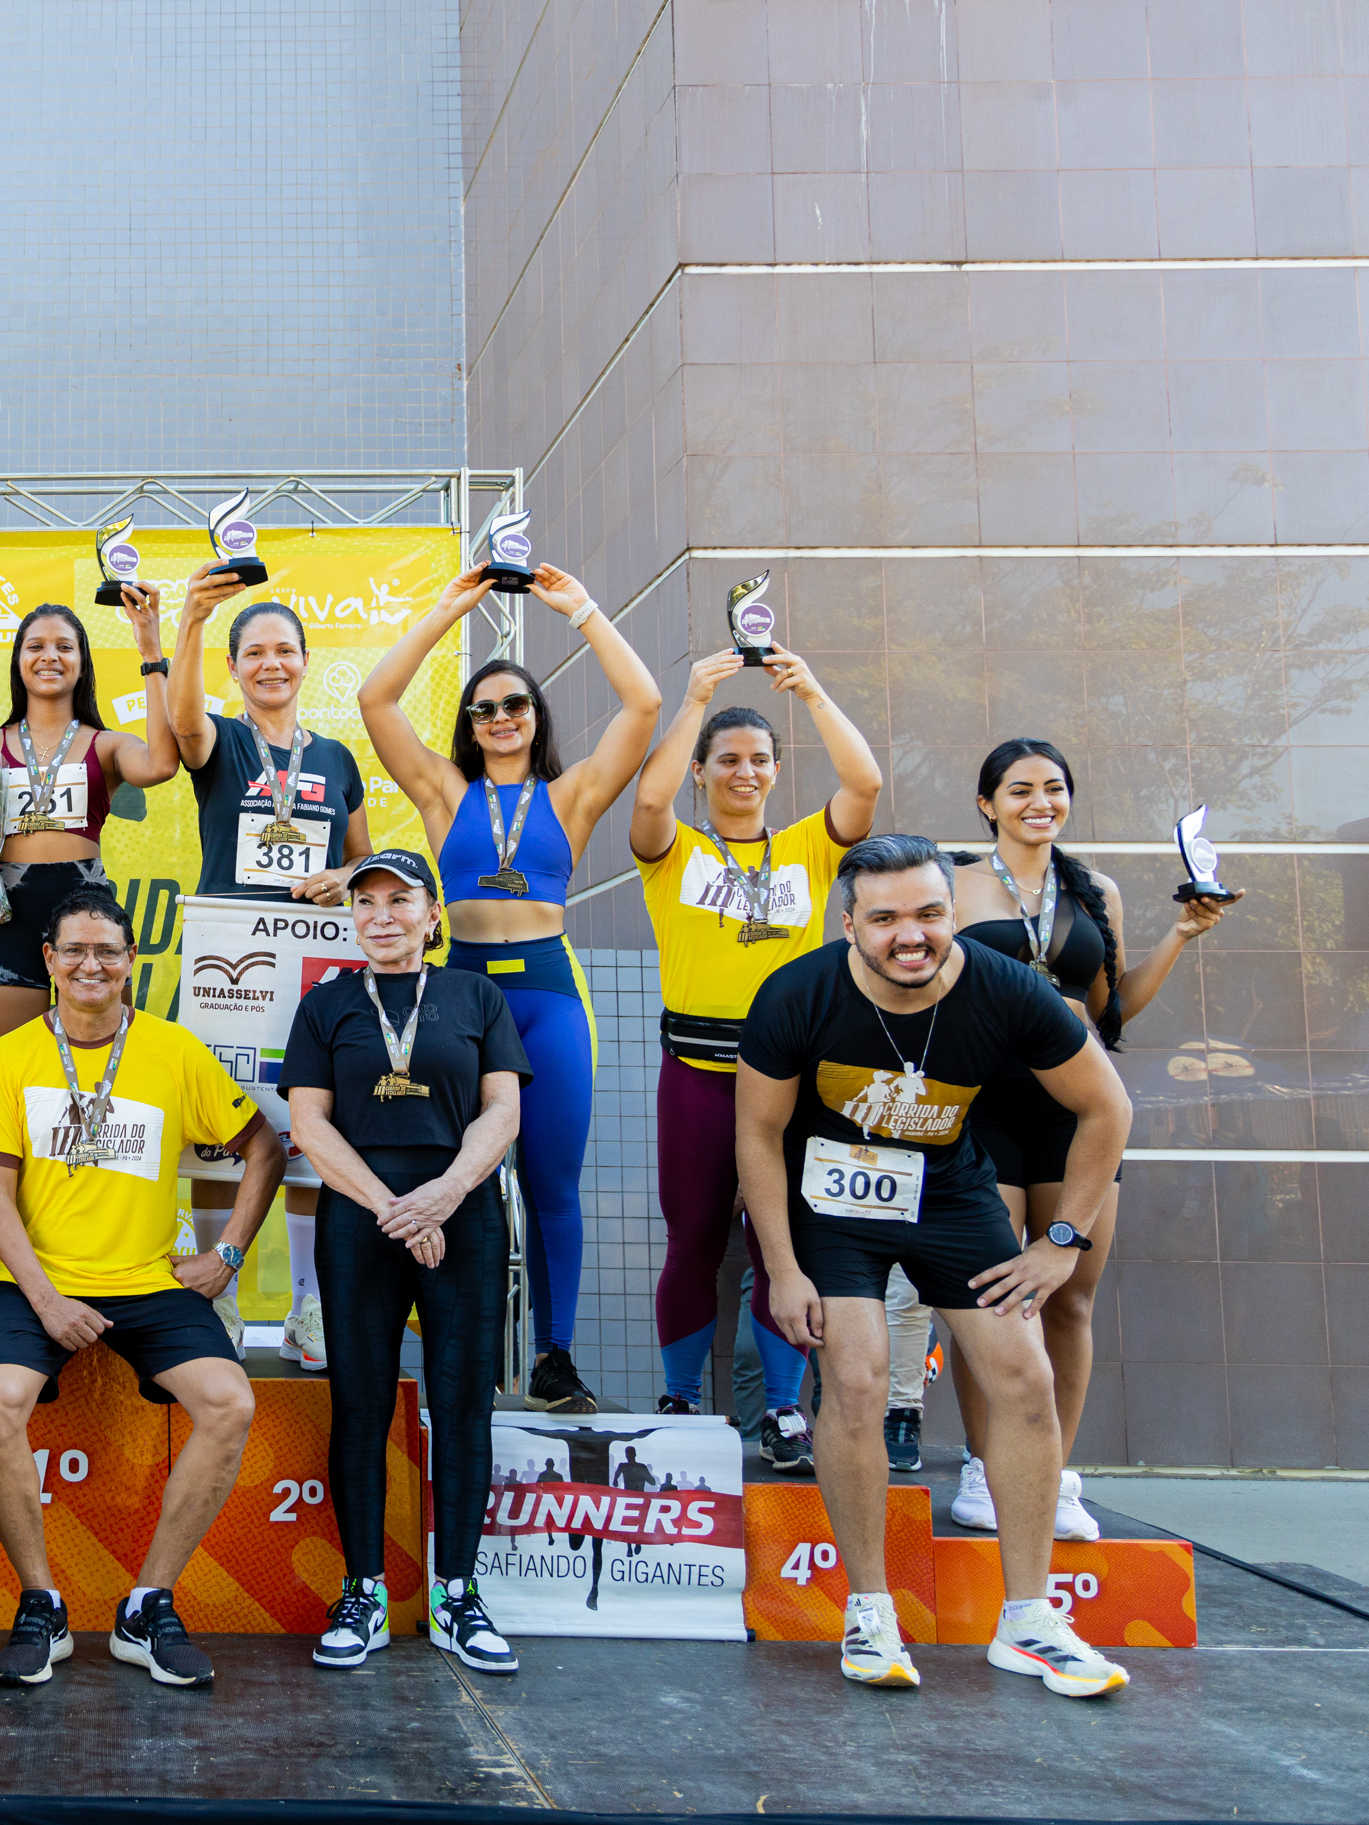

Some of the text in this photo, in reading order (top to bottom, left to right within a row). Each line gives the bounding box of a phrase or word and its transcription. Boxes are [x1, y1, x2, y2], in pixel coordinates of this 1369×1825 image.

[297, 703, 362, 723] pontoc
[240, 799, 271, 808] ASSOCIAÇÃO
[297, 803, 320, 812] FABIANO
[320, 805, 335, 816] GOMES
[255, 842, 311, 873] 381
[780, 880, 791, 895] DO
[251, 917, 348, 942] APOIO:
[193, 986, 275, 1002] UNIASSELVI
[199, 1001, 266, 1013] GRADUAÇÃO E PÓS
[882, 1102, 959, 1119] CORRIDA DO
[131, 1124, 145, 1139] DO
[881, 1115, 956, 1132] LEGISLADOR
[201, 1146, 211, 1158] do
[824, 1168, 897, 1202] 300
[475, 1551, 725, 1587] SAFIANDO GIGANTES
